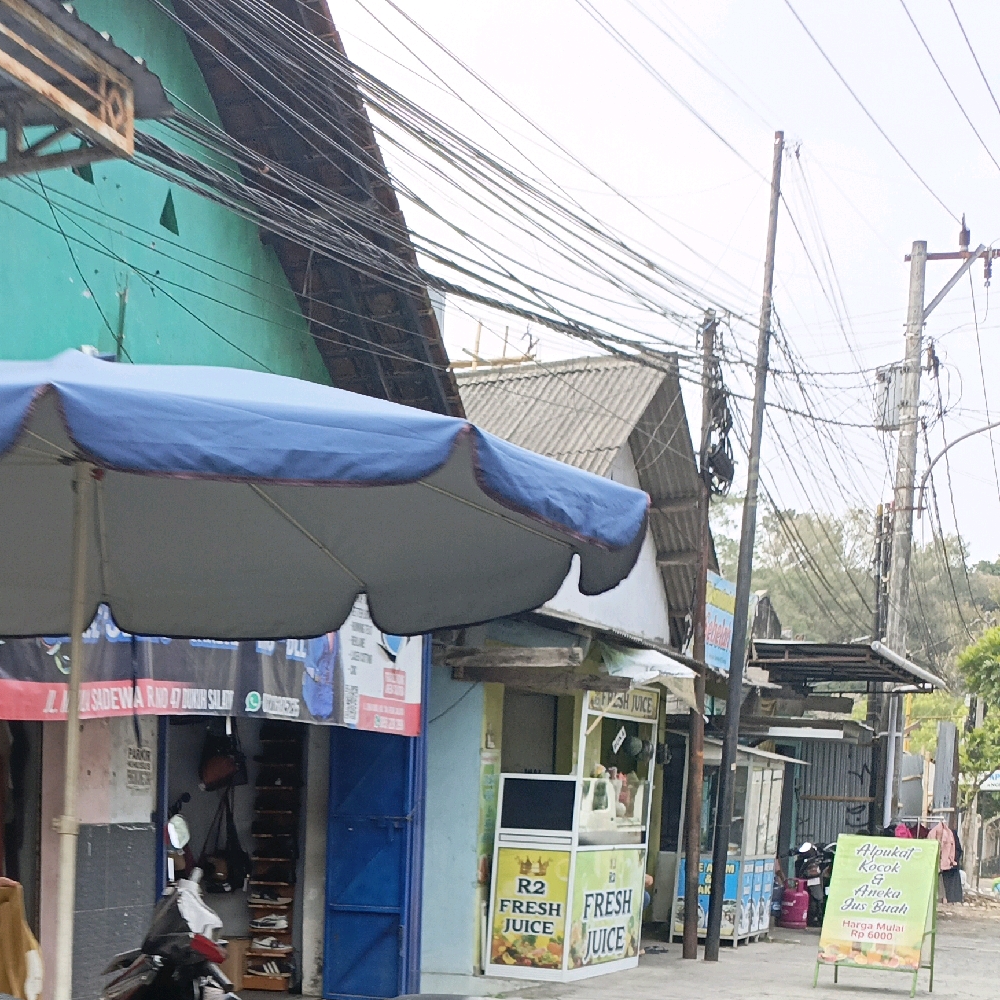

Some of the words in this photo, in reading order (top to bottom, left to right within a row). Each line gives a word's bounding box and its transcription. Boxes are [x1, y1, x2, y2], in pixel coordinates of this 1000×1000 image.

[631, 694, 654, 713] JUICE
[856, 843, 921, 862] Alpukat
[858, 860, 901, 873] Kocok
[516, 878, 546, 895] R2
[871, 873, 884, 886] &
[854, 884, 901, 899] Aneka
[499, 898, 562, 917] FRESH
[582, 888, 633, 921] FRESH
[840, 898, 867, 911] Jus
[871, 899, 908, 914] Buah
[503, 918, 554, 935] JUICE
[842, 919, 873, 931] Harga
[876, 923, 904, 933] Mulai
[584, 926, 625, 961] JUICE
[850, 930, 865, 939] Rp
[868, 931, 893, 941] 6000
